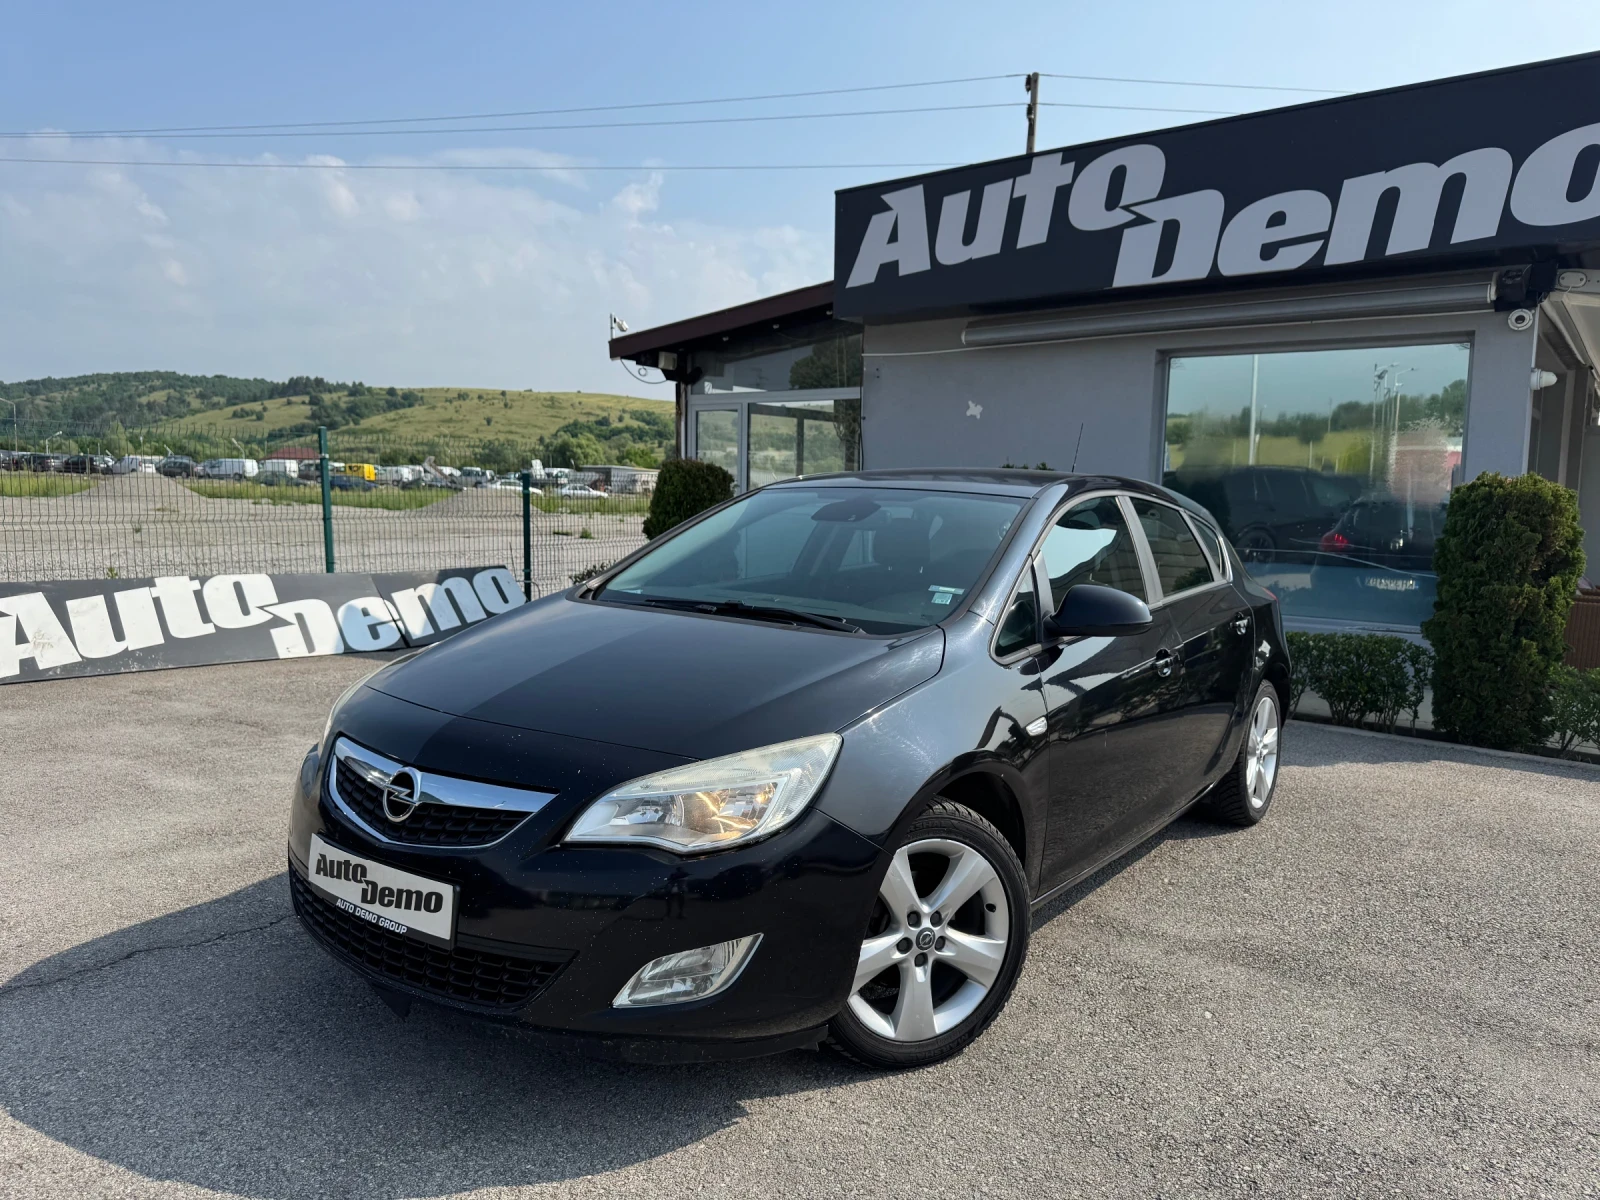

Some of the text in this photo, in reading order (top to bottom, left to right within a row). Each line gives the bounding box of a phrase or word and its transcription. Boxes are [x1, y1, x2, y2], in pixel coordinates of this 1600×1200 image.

[845, 122, 1600, 289] Auto Demo
[0, 567, 526, 678] Auto Demo
[315, 853, 443, 913] Auto Demo
[336, 899, 407, 934] AUTO DEMO GROUP
